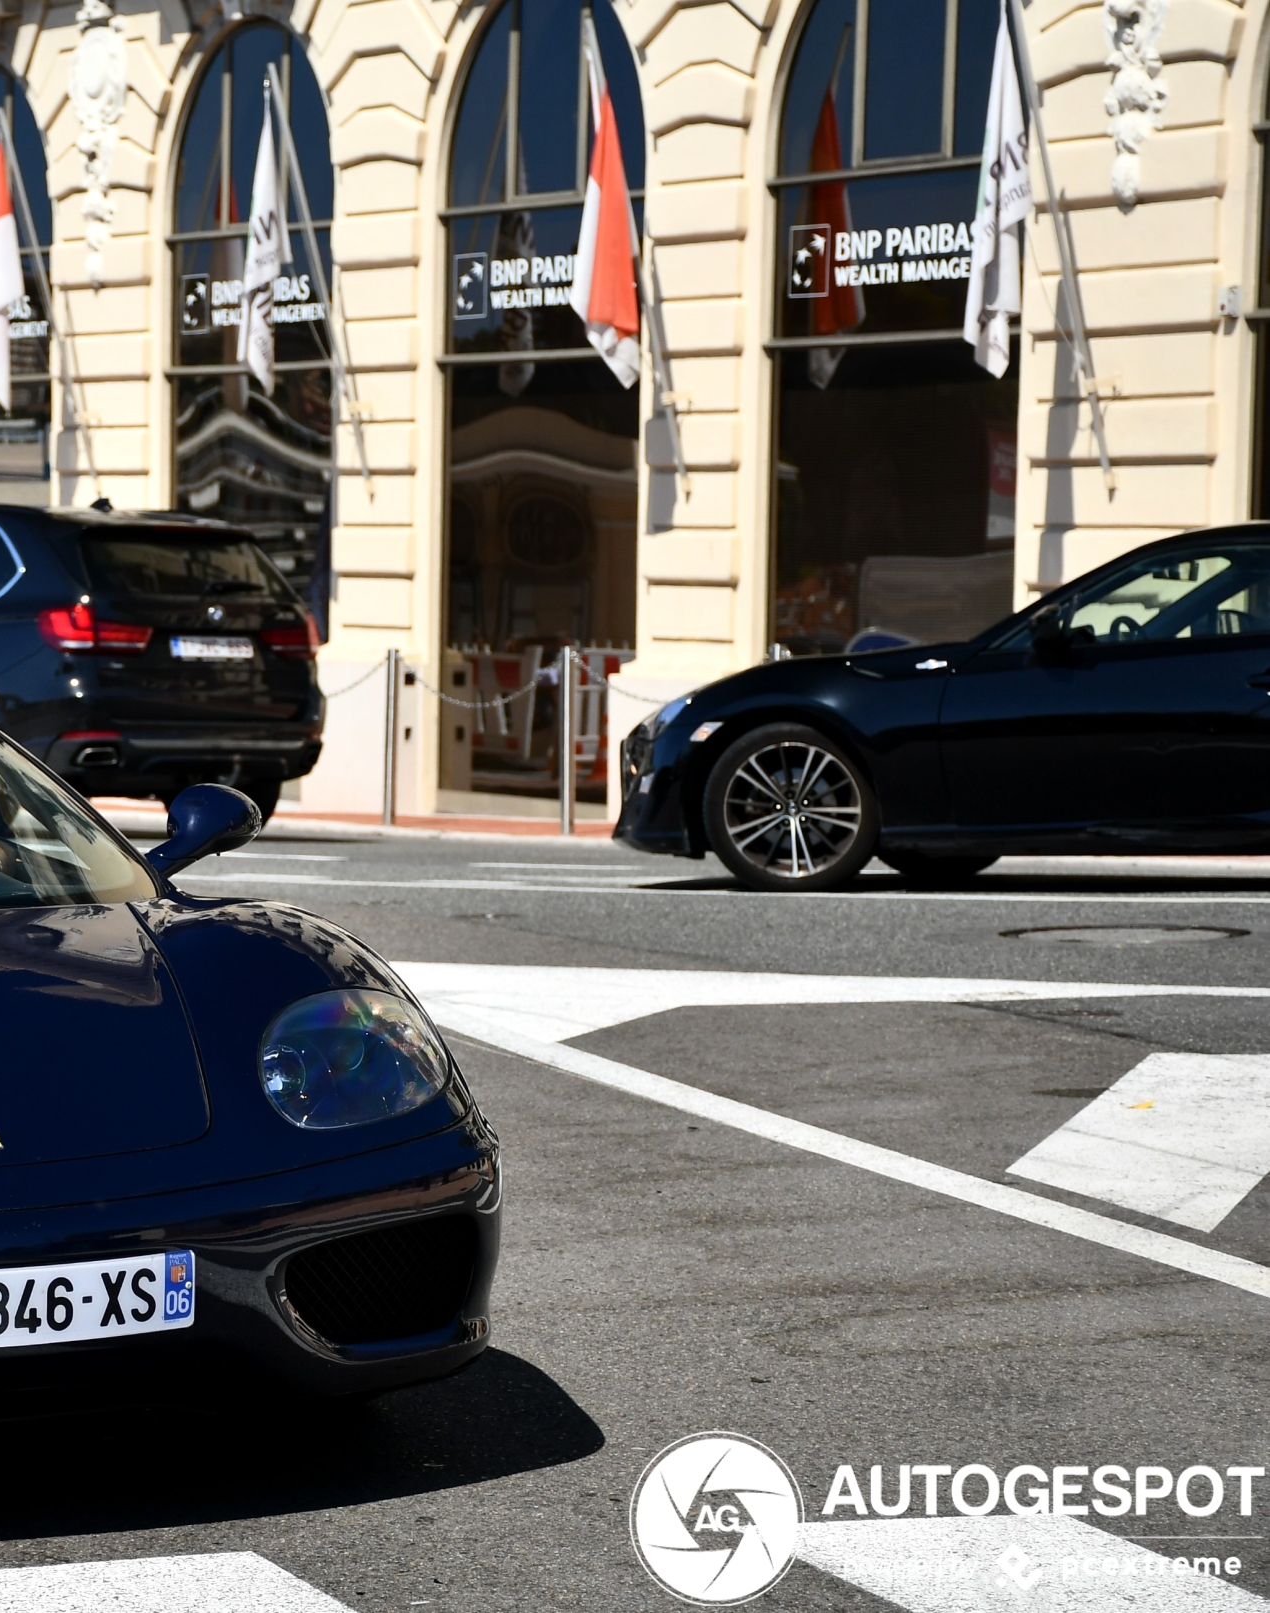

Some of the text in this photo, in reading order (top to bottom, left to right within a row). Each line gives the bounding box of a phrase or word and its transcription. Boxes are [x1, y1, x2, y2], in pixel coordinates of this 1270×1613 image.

[835, 230, 882, 261] BNP
[490, 254, 575, 287] BNP PARI
[834, 256, 971, 287] WEALTH MANAGE
[211, 274, 310, 306] BNP IBAS
[490, 288, 543, 310] WEALTH
[211, 308, 242, 327] WEAL
[165, 1288, 190, 1315] 06
